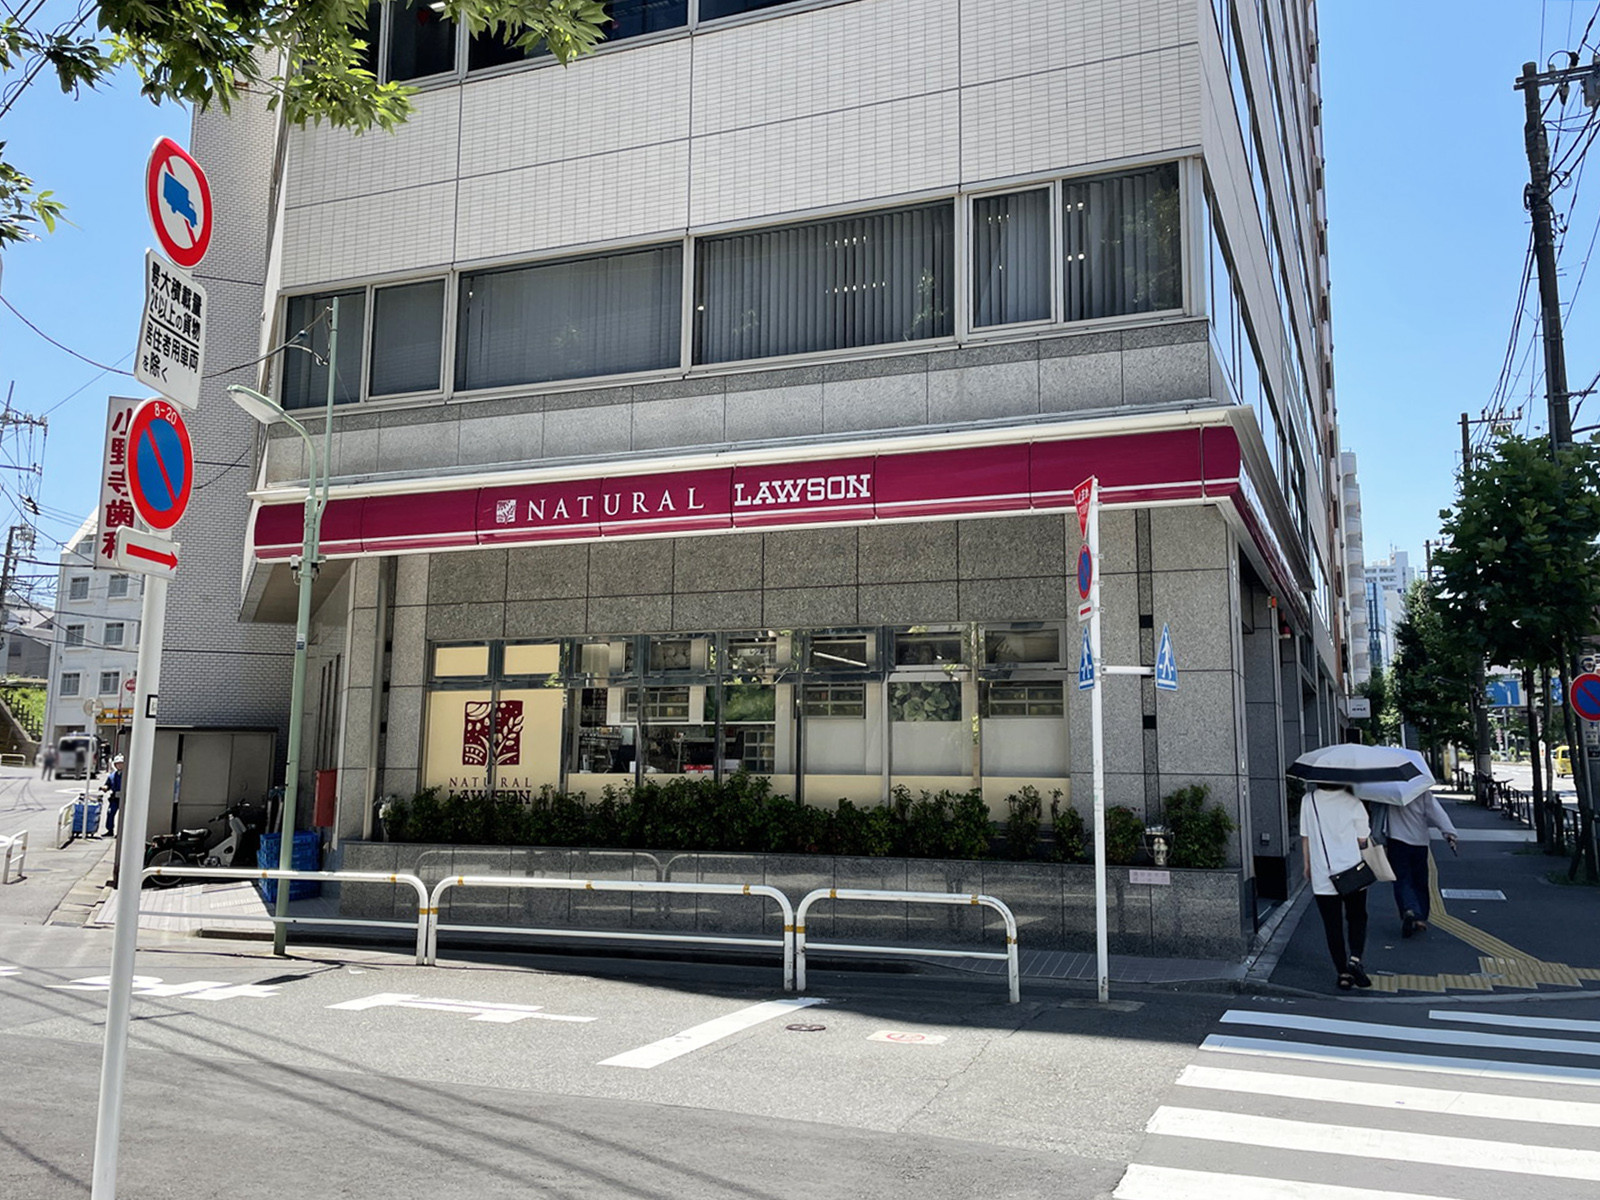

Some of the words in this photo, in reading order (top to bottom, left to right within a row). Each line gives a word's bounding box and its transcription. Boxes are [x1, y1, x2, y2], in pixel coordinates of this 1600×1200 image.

[151, 261, 202, 318] 最大積載量
[142, 351, 169, 384] を除く
[145, 321, 199, 374] 居住者用車両
[154, 402, 178, 425] 8-20
[527, 487, 705, 522] NATURAL
[734, 473, 871, 507] LAWSON
